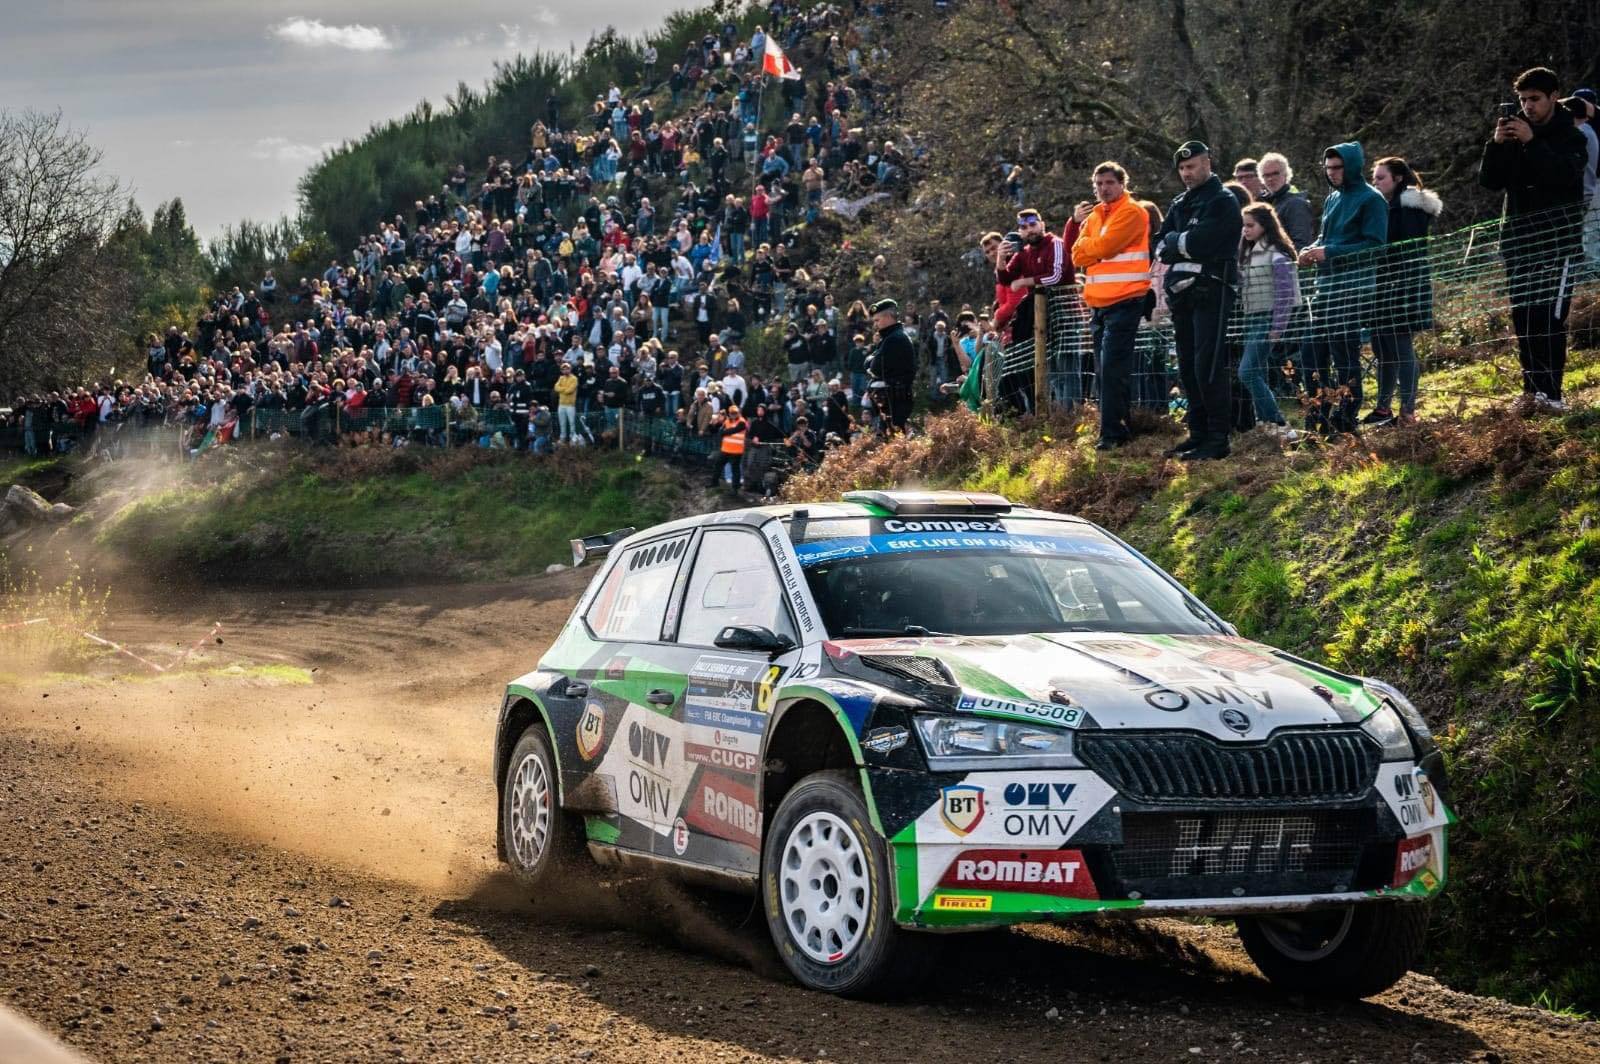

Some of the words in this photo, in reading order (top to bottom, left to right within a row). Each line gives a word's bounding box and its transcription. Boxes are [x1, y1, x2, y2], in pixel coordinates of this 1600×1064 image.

[884, 519, 1006, 533] Compex
[887, 539, 920, 550] ERC
[922, 538, 958, 548] LIVE
[963, 538, 983, 546] ON
[782, 563, 797, 590] RALLY
[791, 590, 814, 633] ACADEMY
[1144, 684, 1274, 712] OMV
[585, 713, 601, 735] BT
[629, 770, 671, 818] OMV
[949, 797, 976, 814] BT
[1004, 814, 1076, 836] OMV
[940, 896, 987, 909] PIRELLI
